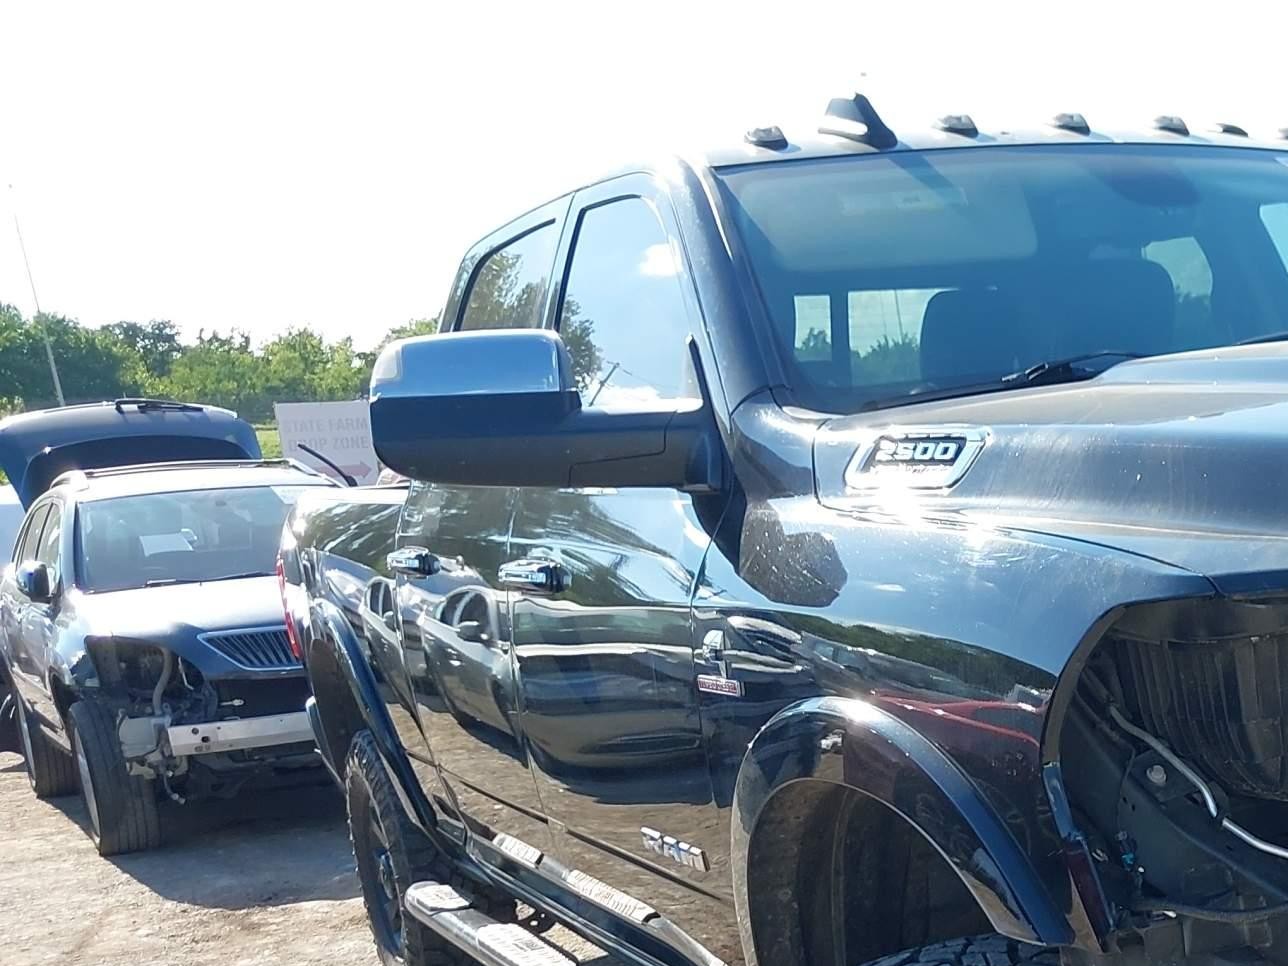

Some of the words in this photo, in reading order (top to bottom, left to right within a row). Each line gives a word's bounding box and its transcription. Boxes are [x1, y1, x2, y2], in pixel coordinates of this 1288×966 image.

[286, 419, 323, 433] STATE
[328, 417, 368, 432] FARM
[332, 436, 369, 450] ZONE
[875, 440, 958, 461] 2500
